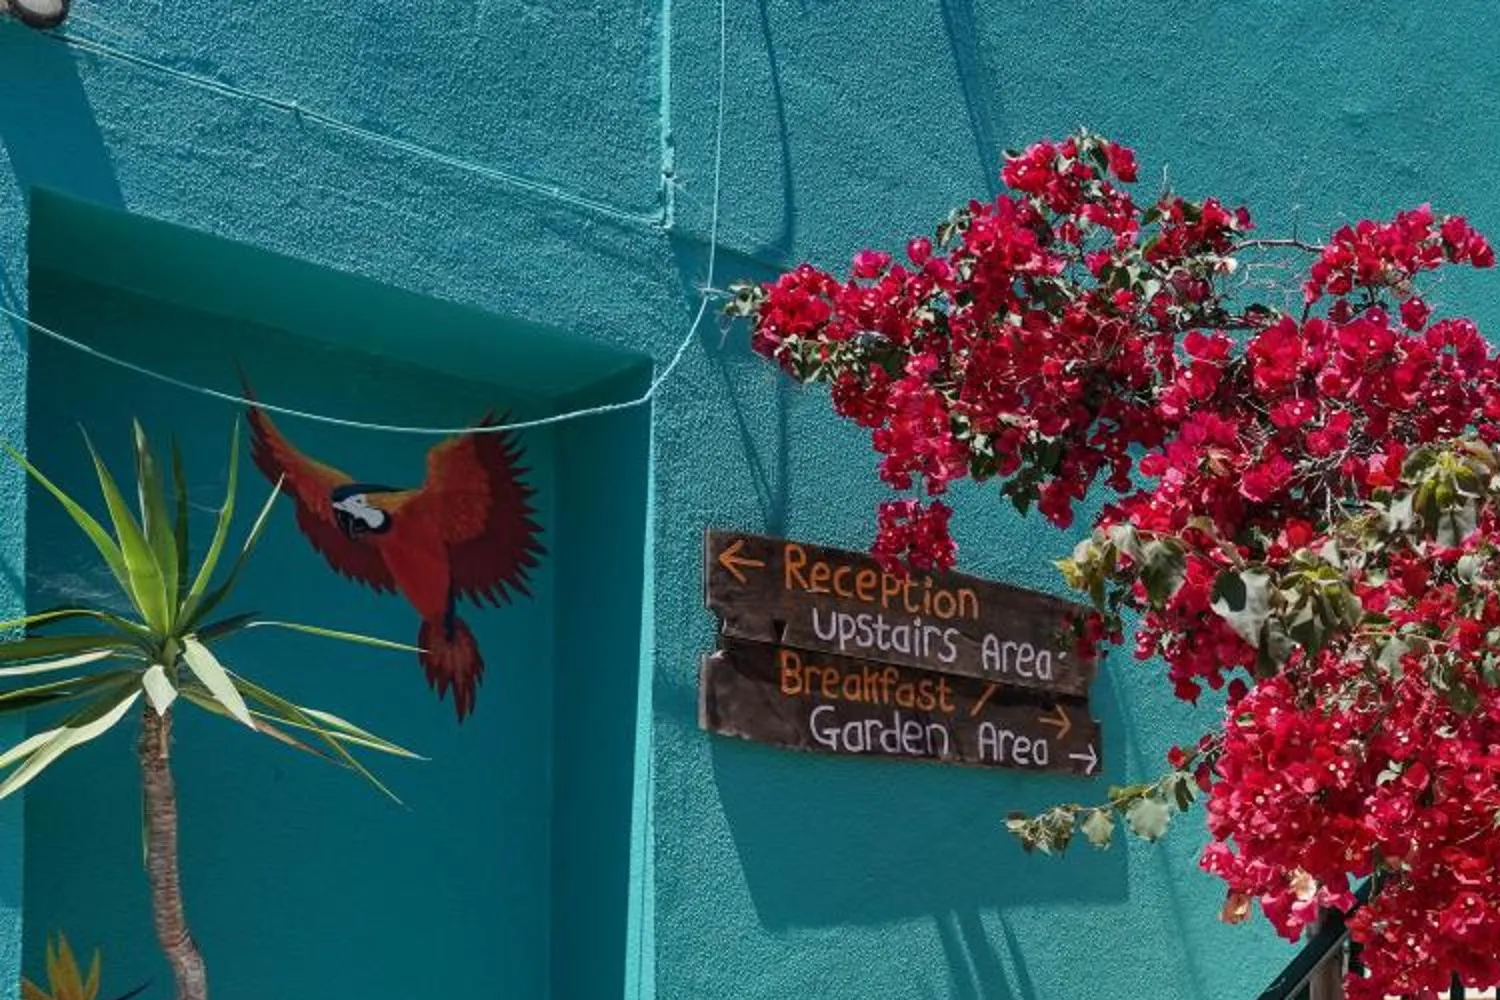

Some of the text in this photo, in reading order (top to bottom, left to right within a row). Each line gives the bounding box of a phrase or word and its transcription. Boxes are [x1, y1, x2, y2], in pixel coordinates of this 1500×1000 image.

[783, 543, 979, 620] Reception
[780, 650, 956, 713] Breakfast
[981, 633, 1053, 679] Area
[810, 705, 1049, 764] Garden Area
